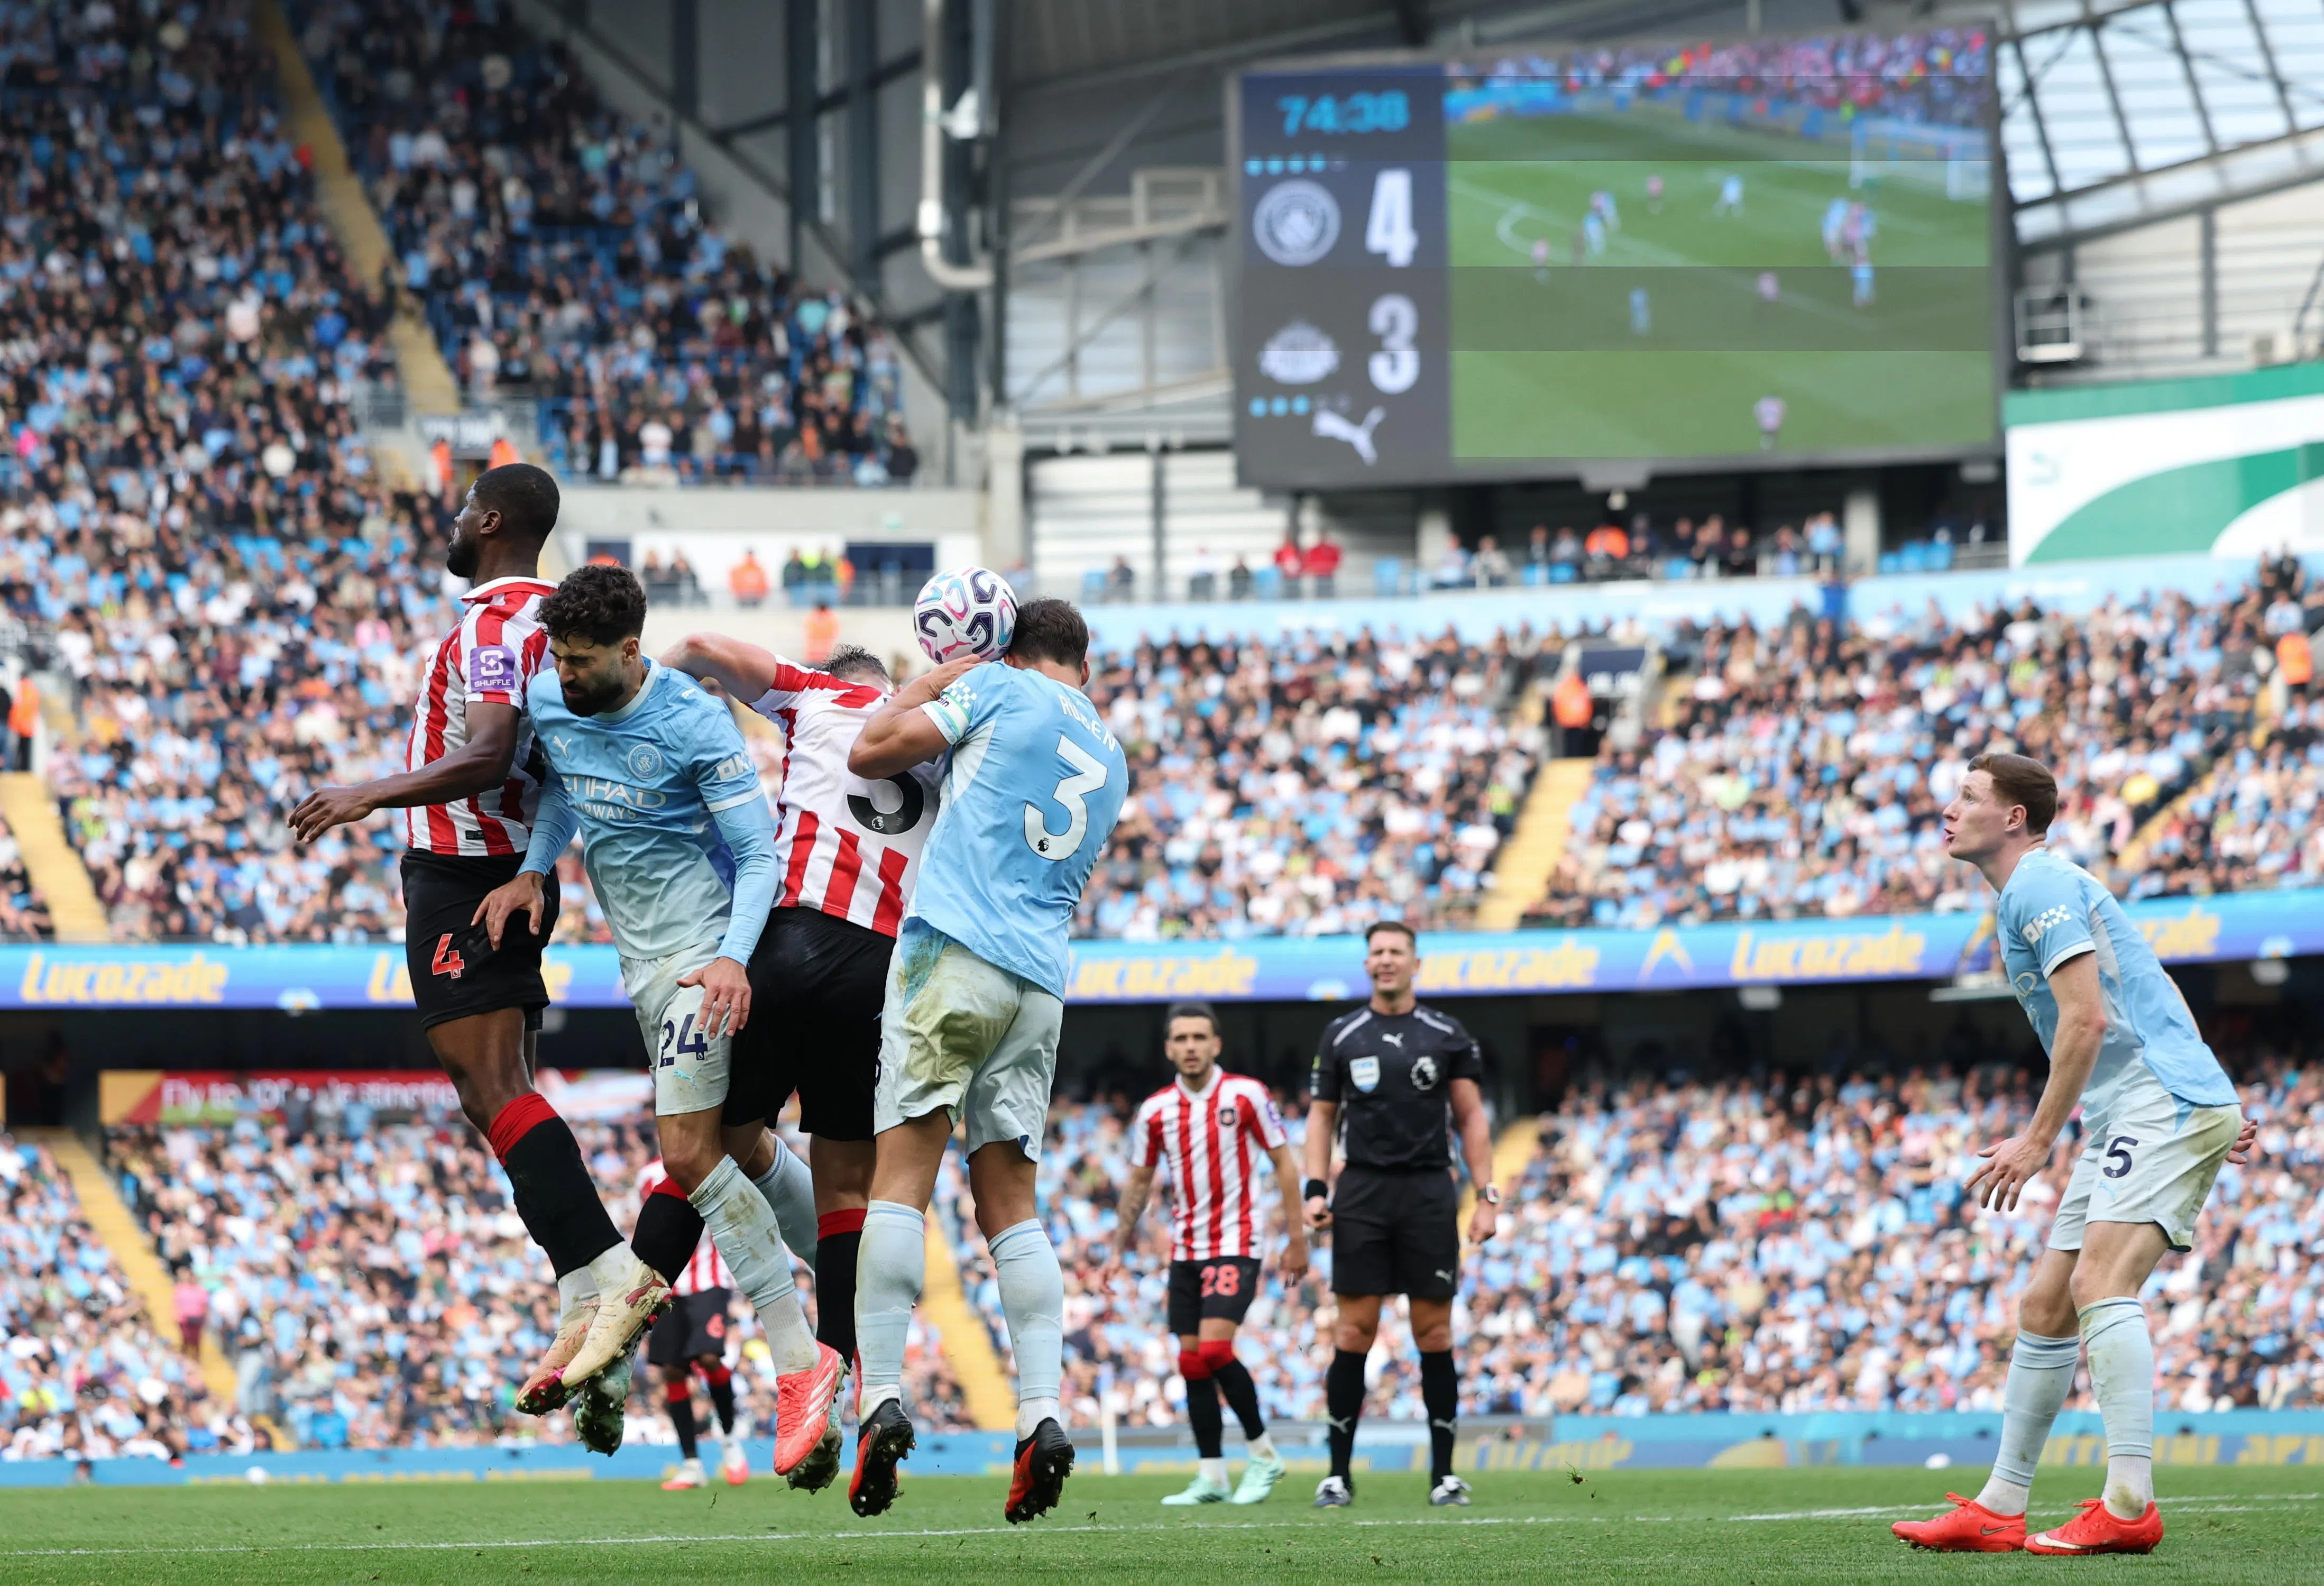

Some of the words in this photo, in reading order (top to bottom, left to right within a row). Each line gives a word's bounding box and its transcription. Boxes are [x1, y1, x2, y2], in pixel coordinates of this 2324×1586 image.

[1366, 168, 1417, 267] 4
[1368, 294, 1419, 394] 3
[474, 679, 511, 687] SHUFFLE
[561, 775, 666, 809] ETIHAD
[1024, 734, 1108, 861] 3
[432, 933, 465, 979] 4
[1732, 923, 1924, 979] Lucozade
[21, 951, 228, 1002] Lucozade
[659, 1013, 708, 1067] 24
[2103, 1136, 2139, 1178] 5
[1200, 1264, 1241, 1298] 28
[706, 1313, 727, 1339] 6
